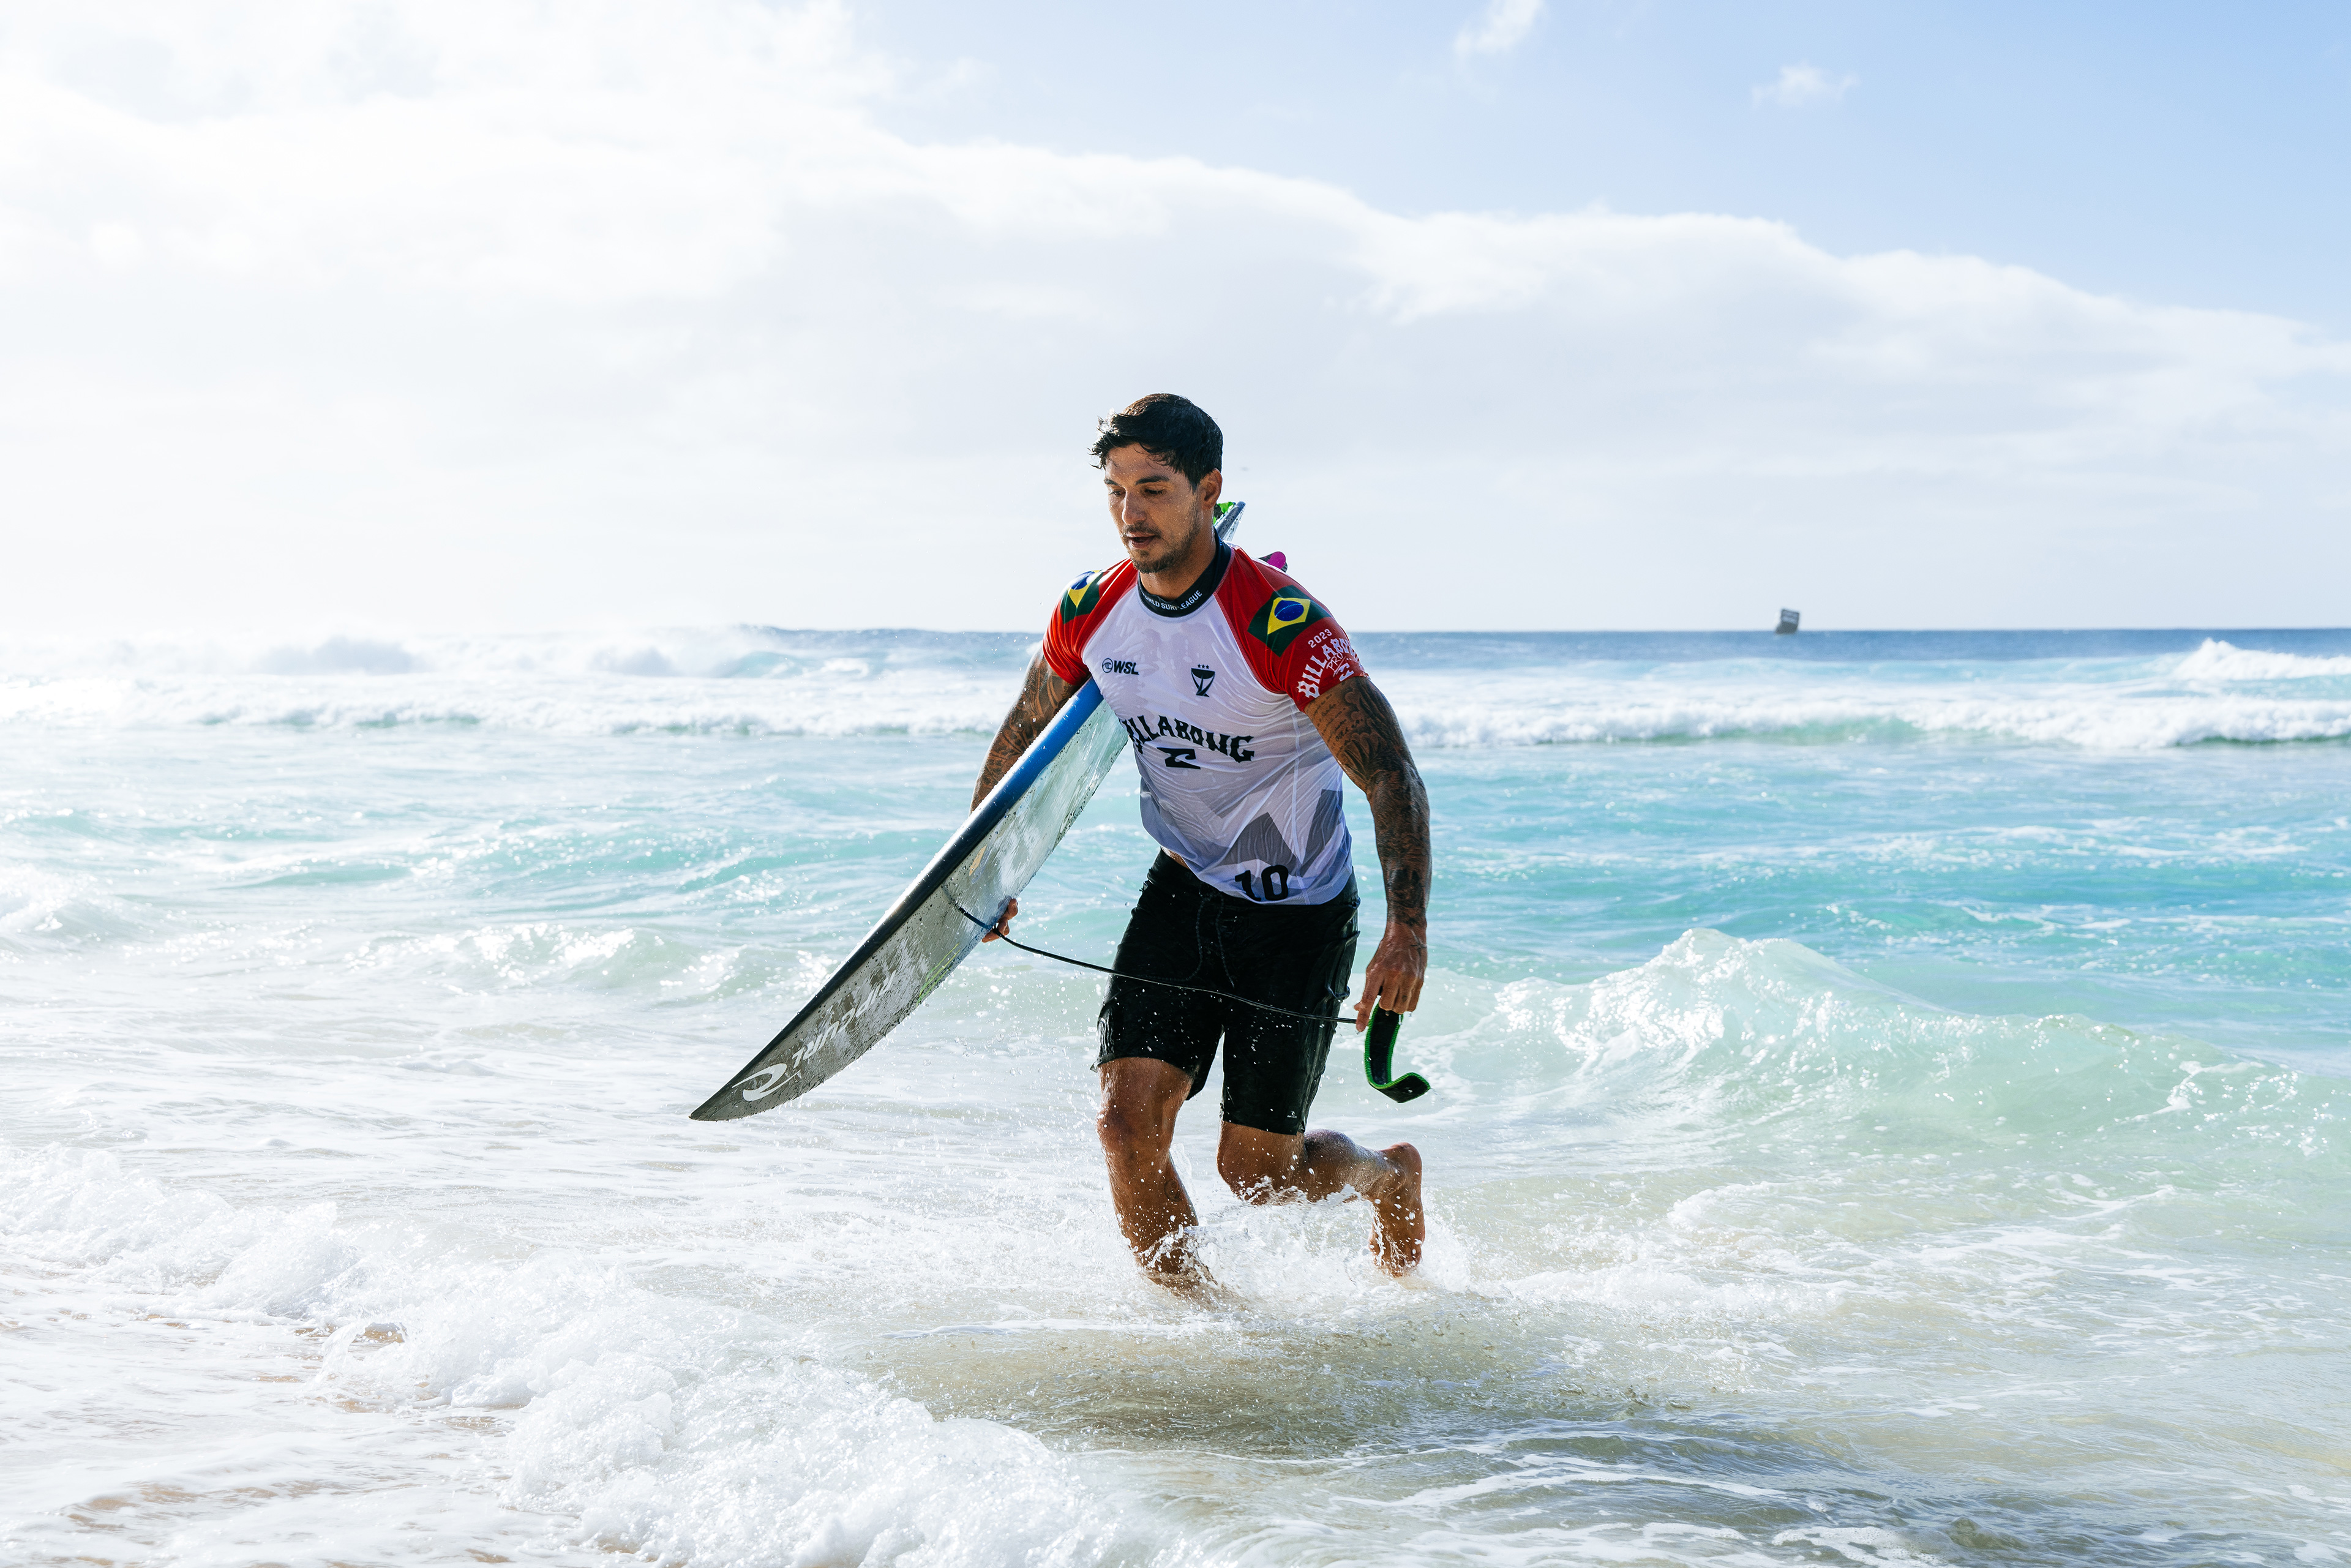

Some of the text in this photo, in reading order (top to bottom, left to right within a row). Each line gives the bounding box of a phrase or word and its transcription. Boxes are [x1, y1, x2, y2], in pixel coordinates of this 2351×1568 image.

[1308, 629, 1332, 648] 2023
[1114, 660, 1140, 675] WSL
[1296, 637, 1365, 699] BILLABON
[1119, 715, 1255, 763] ILLABONG
[1234, 864, 1289, 902] 10
